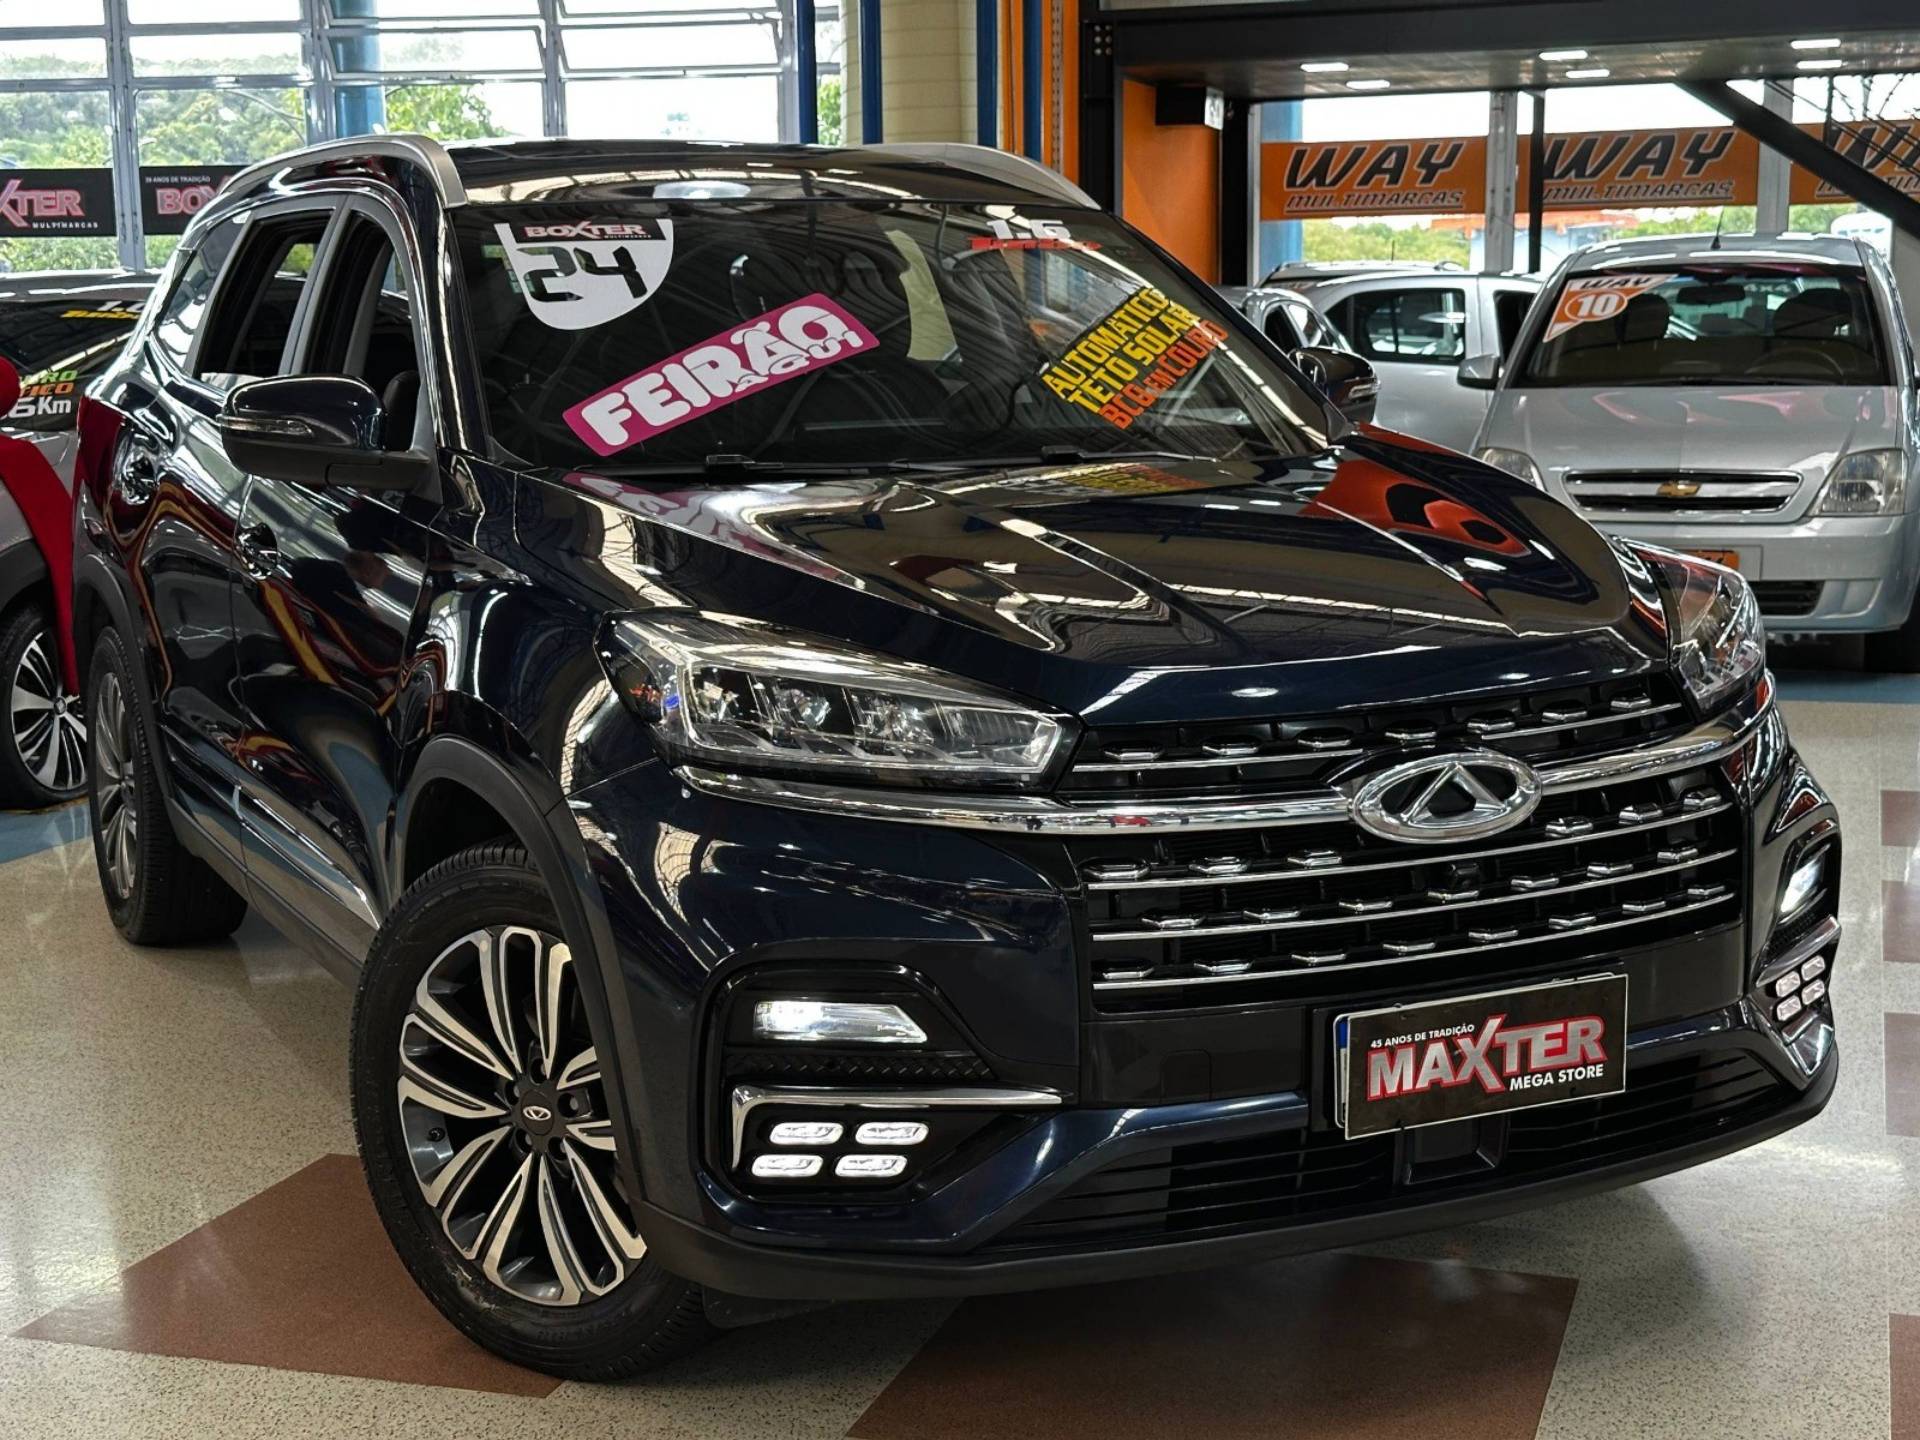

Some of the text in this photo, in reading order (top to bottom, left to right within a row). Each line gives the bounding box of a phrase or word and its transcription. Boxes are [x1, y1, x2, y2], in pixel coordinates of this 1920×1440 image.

[1284, 140, 1466, 190] WAY
[1544, 130, 1737, 181] WAY
[1286, 191, 1464, 210] MULTIMARCAS
[32, 221, 98, 229] MULTIMARCAS
[524, 221, 647, 239] BOXTER
[986, 219, 1071, 239] 1.6
[516, 245, 648, 302] 24
[1581, 276, 1652, 289] WAY
[1577, 294, 1620, 317] 10
[734, 330, 864, 393] AQUI
[1067, 304, 1201, 414] TETO SOLAR
[1157, 319, 1229, 377] COURO
[581, 305, 851, 446] FEIRÃO
[1370, 1023, 1475, 1048] 45 ANOS DE TRADIÇÃO
[1367, 1013, 1607, 1101] MAXTER
[1510, 1064, 1604, 1091] MEGA STORE
